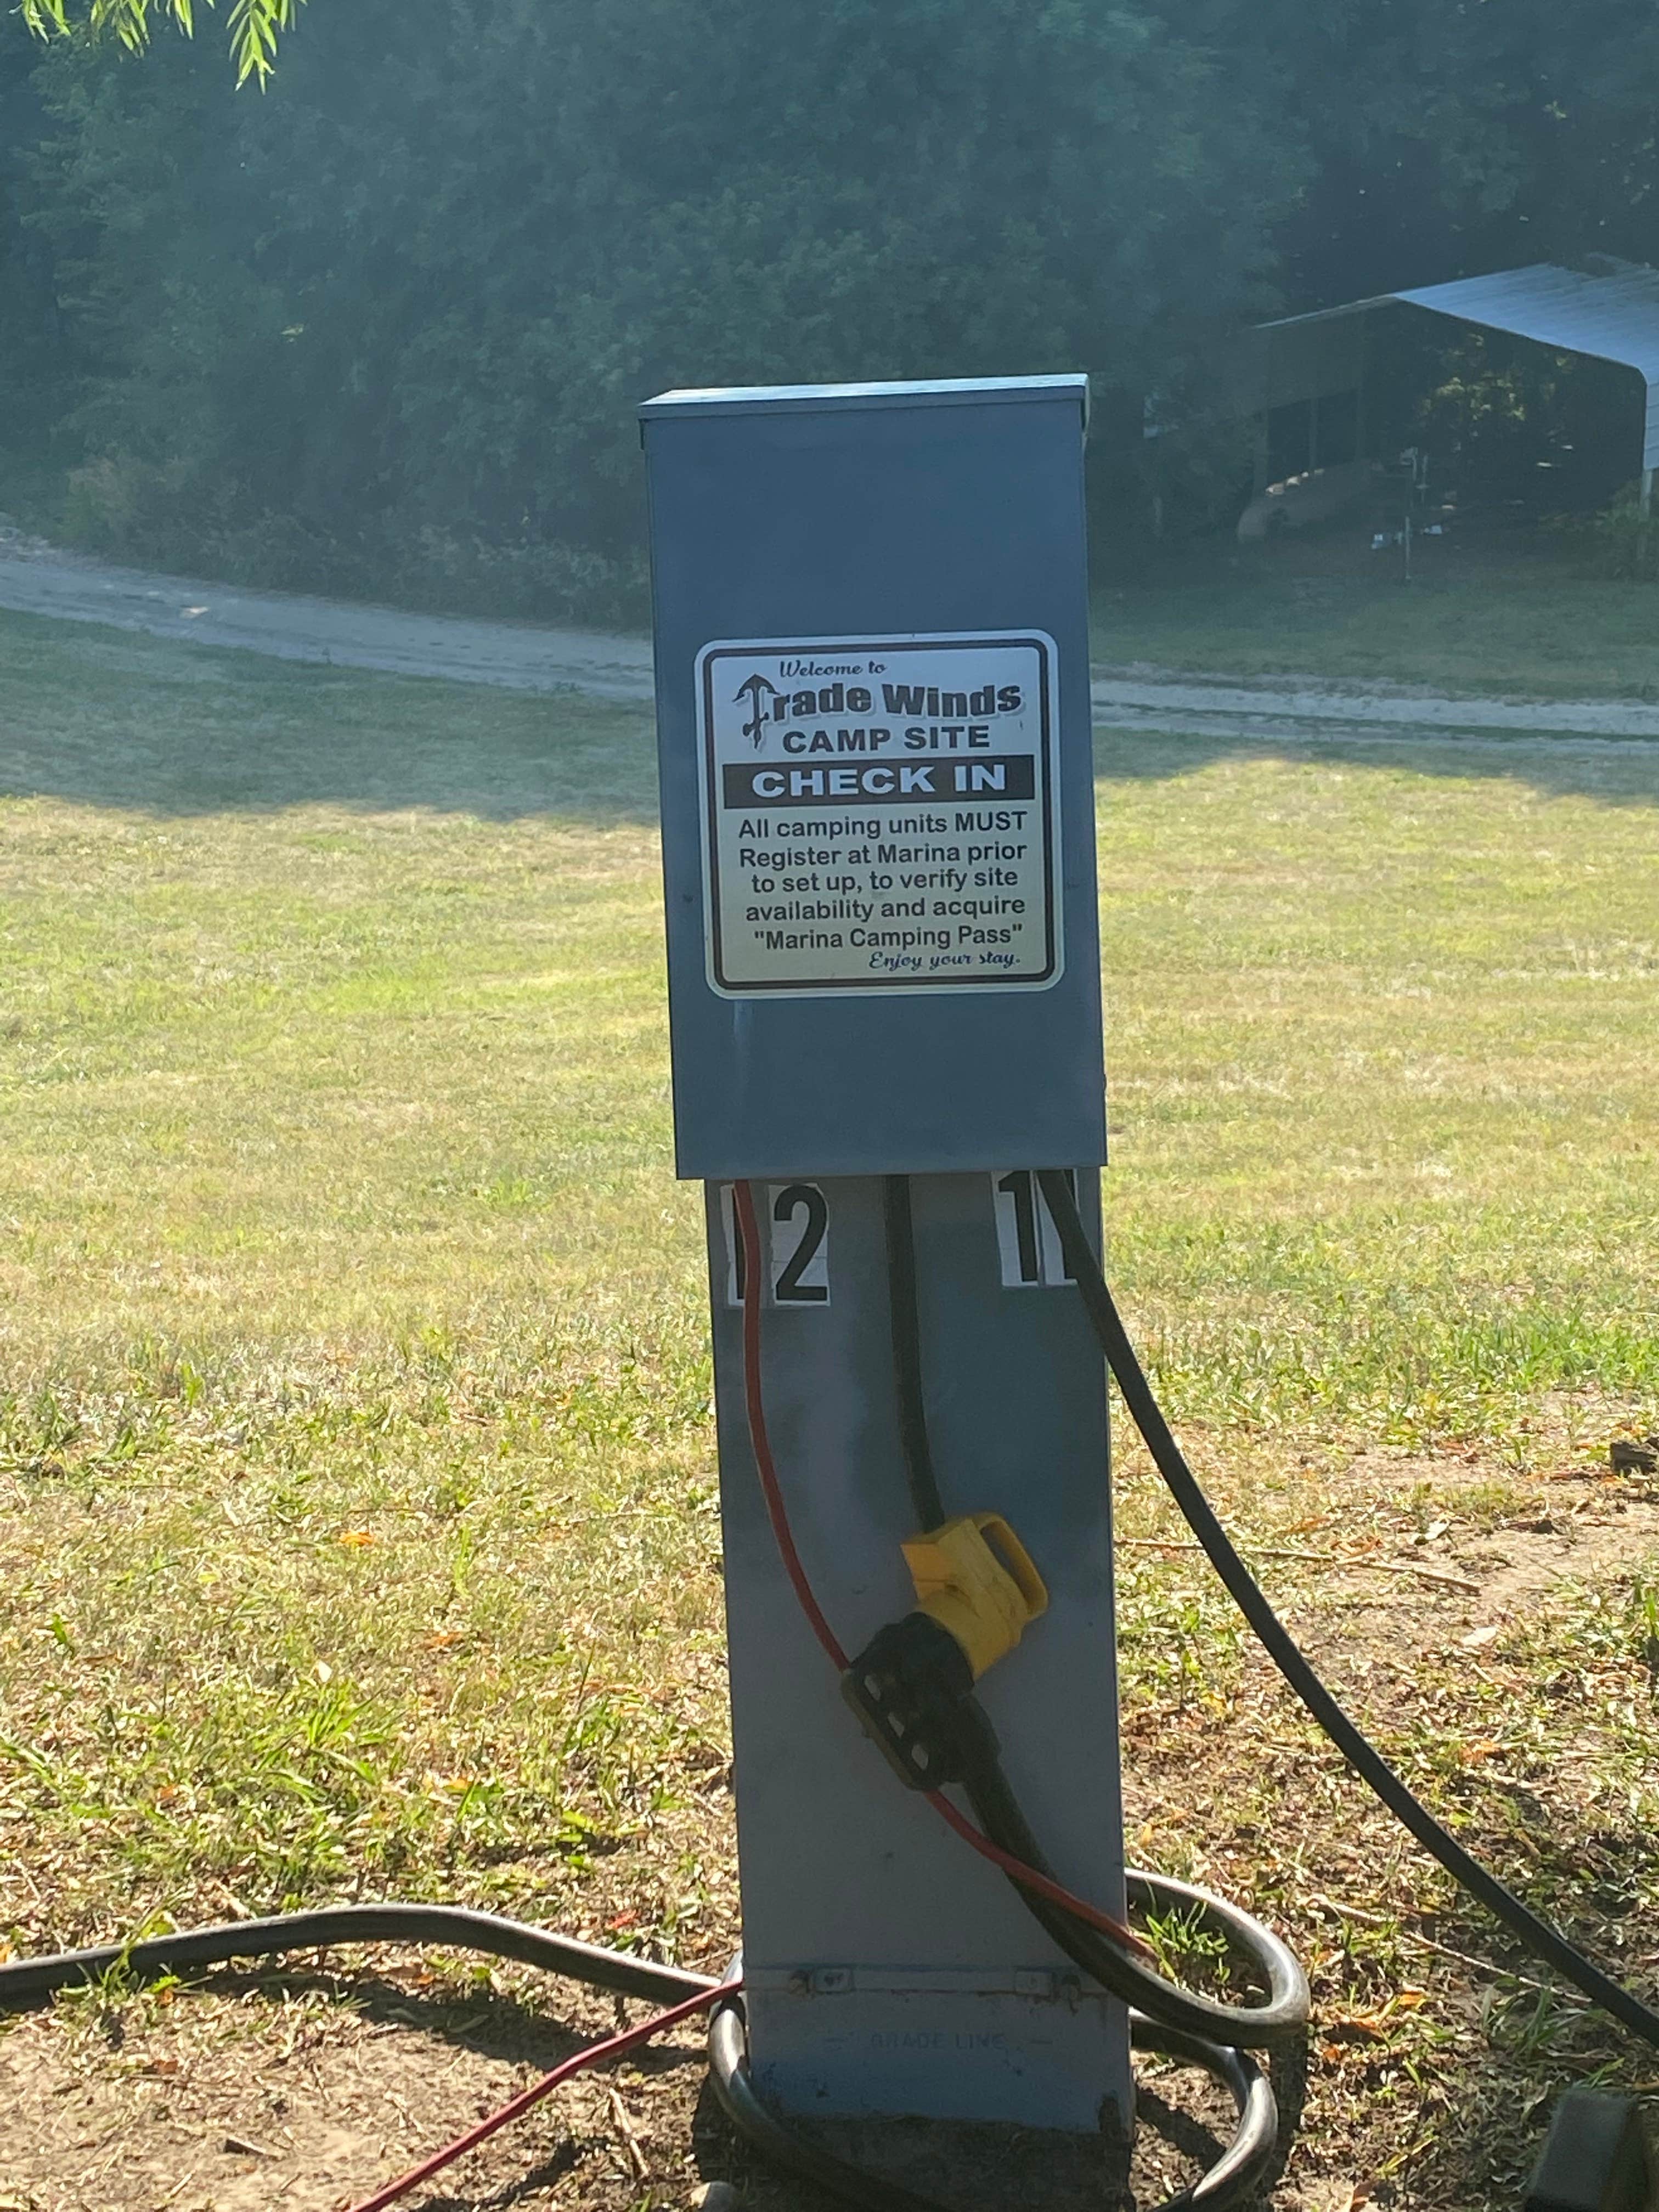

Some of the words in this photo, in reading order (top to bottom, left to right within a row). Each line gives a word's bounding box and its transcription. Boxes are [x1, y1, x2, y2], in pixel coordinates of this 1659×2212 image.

[780, 660, 863, 678] Welcome
[868, 661, 886, 674] to
[882, 684, 1022, 718] Winds
[782, 728, 891, 753] CAMP
[904, 725, 991, 750] SITE
[752, 766, 935, 798] CHECK
[955, 764, 1006, 792] IN
[738, 819, 769, 838] All
[776, 816, 881, 839] camping
[889, 814, 947, 834] units
[955, 811, 1027, 832] MUST
[739, 847, 841, 871] Register
[848, 846, 871, 864] at
[878, 843, 960, 864] Marina
[967, 843, 1027, 865] prior
[752, 875, 775, 893] to
[782, 873, 820, 893] set
[826, 874, 863, 894] up,
[870, 872, 893, 890] to
[900, 869, 967, 893] verify
[974, 868, 1018, 886] site
[746, 900, 873, 923] availability
[881, 897, 926, 918] and
[933, 896, 1025, 918] acquire
[754, 929, 843, 950] "Marina
[850, 927, 950, 951] Camping
[958, 923, 1023, 945] Pass"
[869, 952, 923, 971] Enjoy
[930, 954, 973, 969] your
[979, 952, 1020, 968] stay.
[997, 1169, 1084, 1282] 1
[955, 2032, 1006, 2050] LINE
